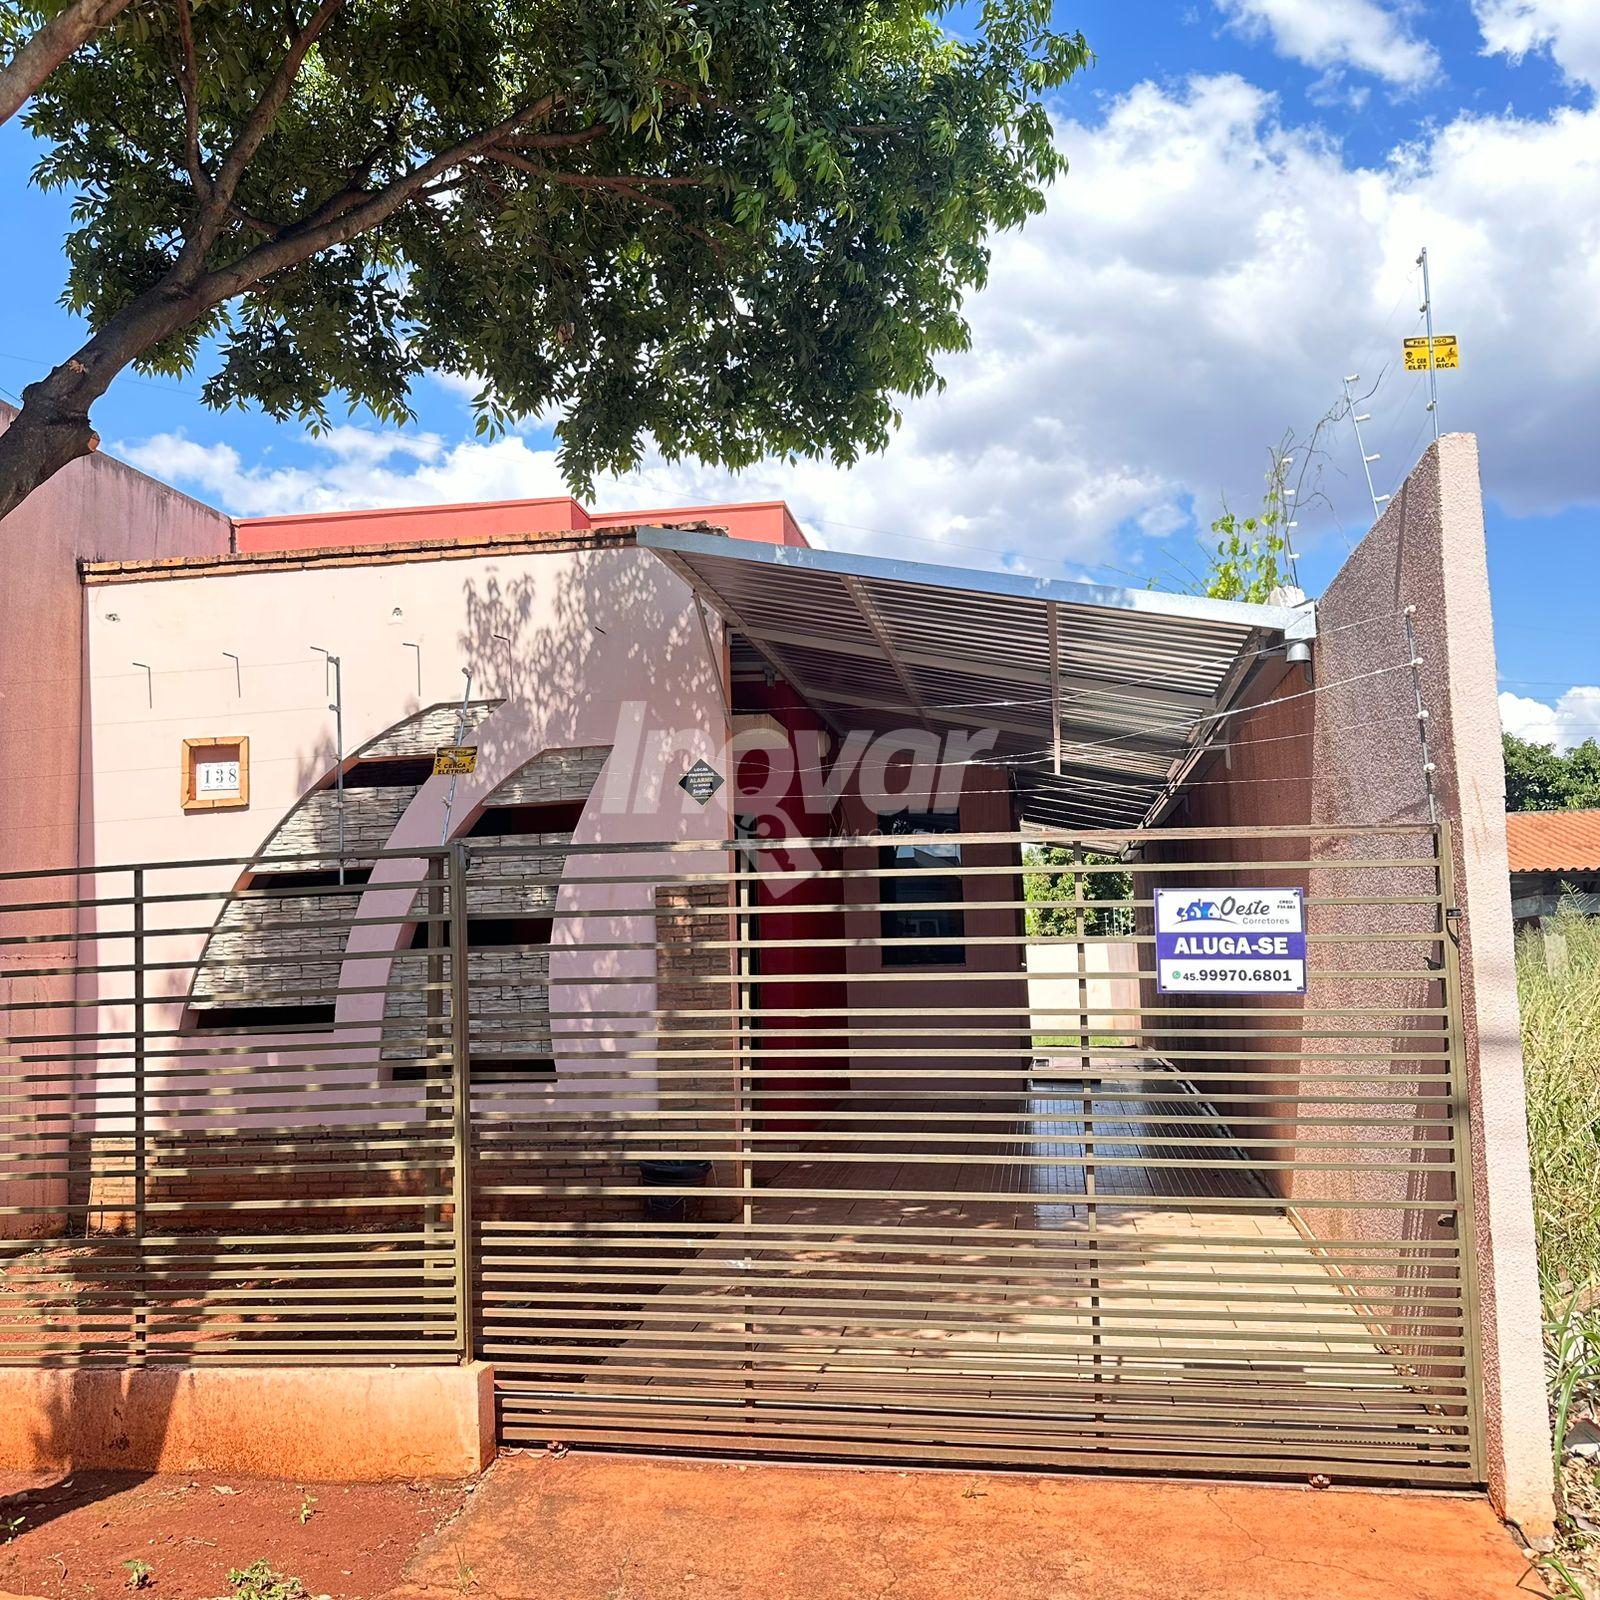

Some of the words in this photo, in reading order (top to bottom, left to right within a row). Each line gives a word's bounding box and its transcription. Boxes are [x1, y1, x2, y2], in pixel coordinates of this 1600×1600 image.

[205, 768, 237, 784] 138
[1220, 896, 1271, 916] Oeste
[1242, 916, 1290, 925] Corretores
[1173, 936, 1289, 955] ALUGA-SE
[1182, 969, 1293, 982] 45.99970.6801
